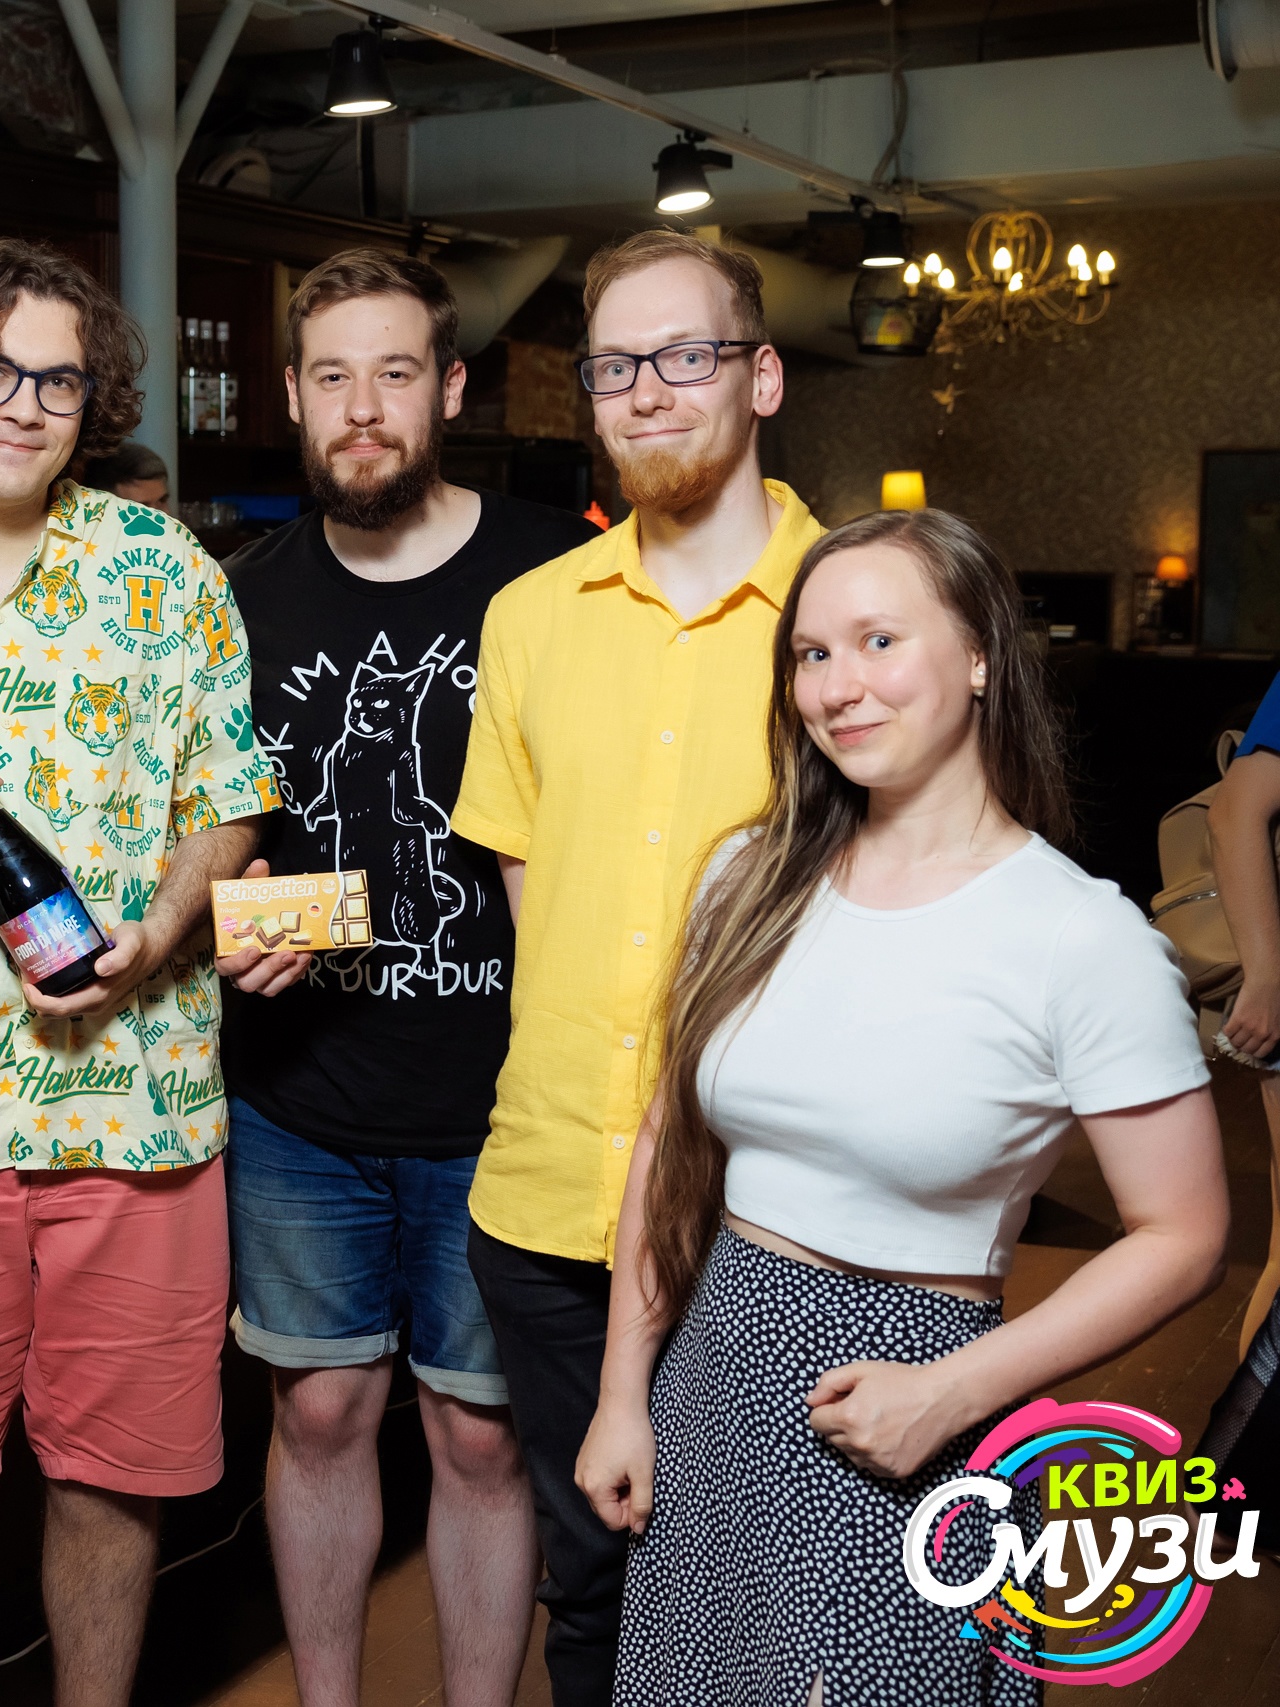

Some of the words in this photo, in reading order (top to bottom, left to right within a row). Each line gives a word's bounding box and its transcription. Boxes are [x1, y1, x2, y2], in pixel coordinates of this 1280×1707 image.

[97, 547, 185, 591] HAWKINS
[98, 595, 121, 605] ESTD
[123, 574, 168, 637] H
[169, 603, 185, 613] 195
[100, 617, 138, 654] HIGH
[141, 630, 186, 661] SCHOOL
[366, 630, 398, 666] A
[189, 668, 218, 692] HIGH
[229, 801, 253, 814] ESTD
[98, 814, 123, 852] HIGH
[216, 878, 318, 904] Schogetten
[14, 940, 40, 962] FIORI
[37, 931, 53, 949] DI
[48, 914, 82, 942] MARE
[437, 958, 504, 996] DUR
[145, 993, 166, 1004] 1952
[16, 1055, 140, 1107] Hawkins
